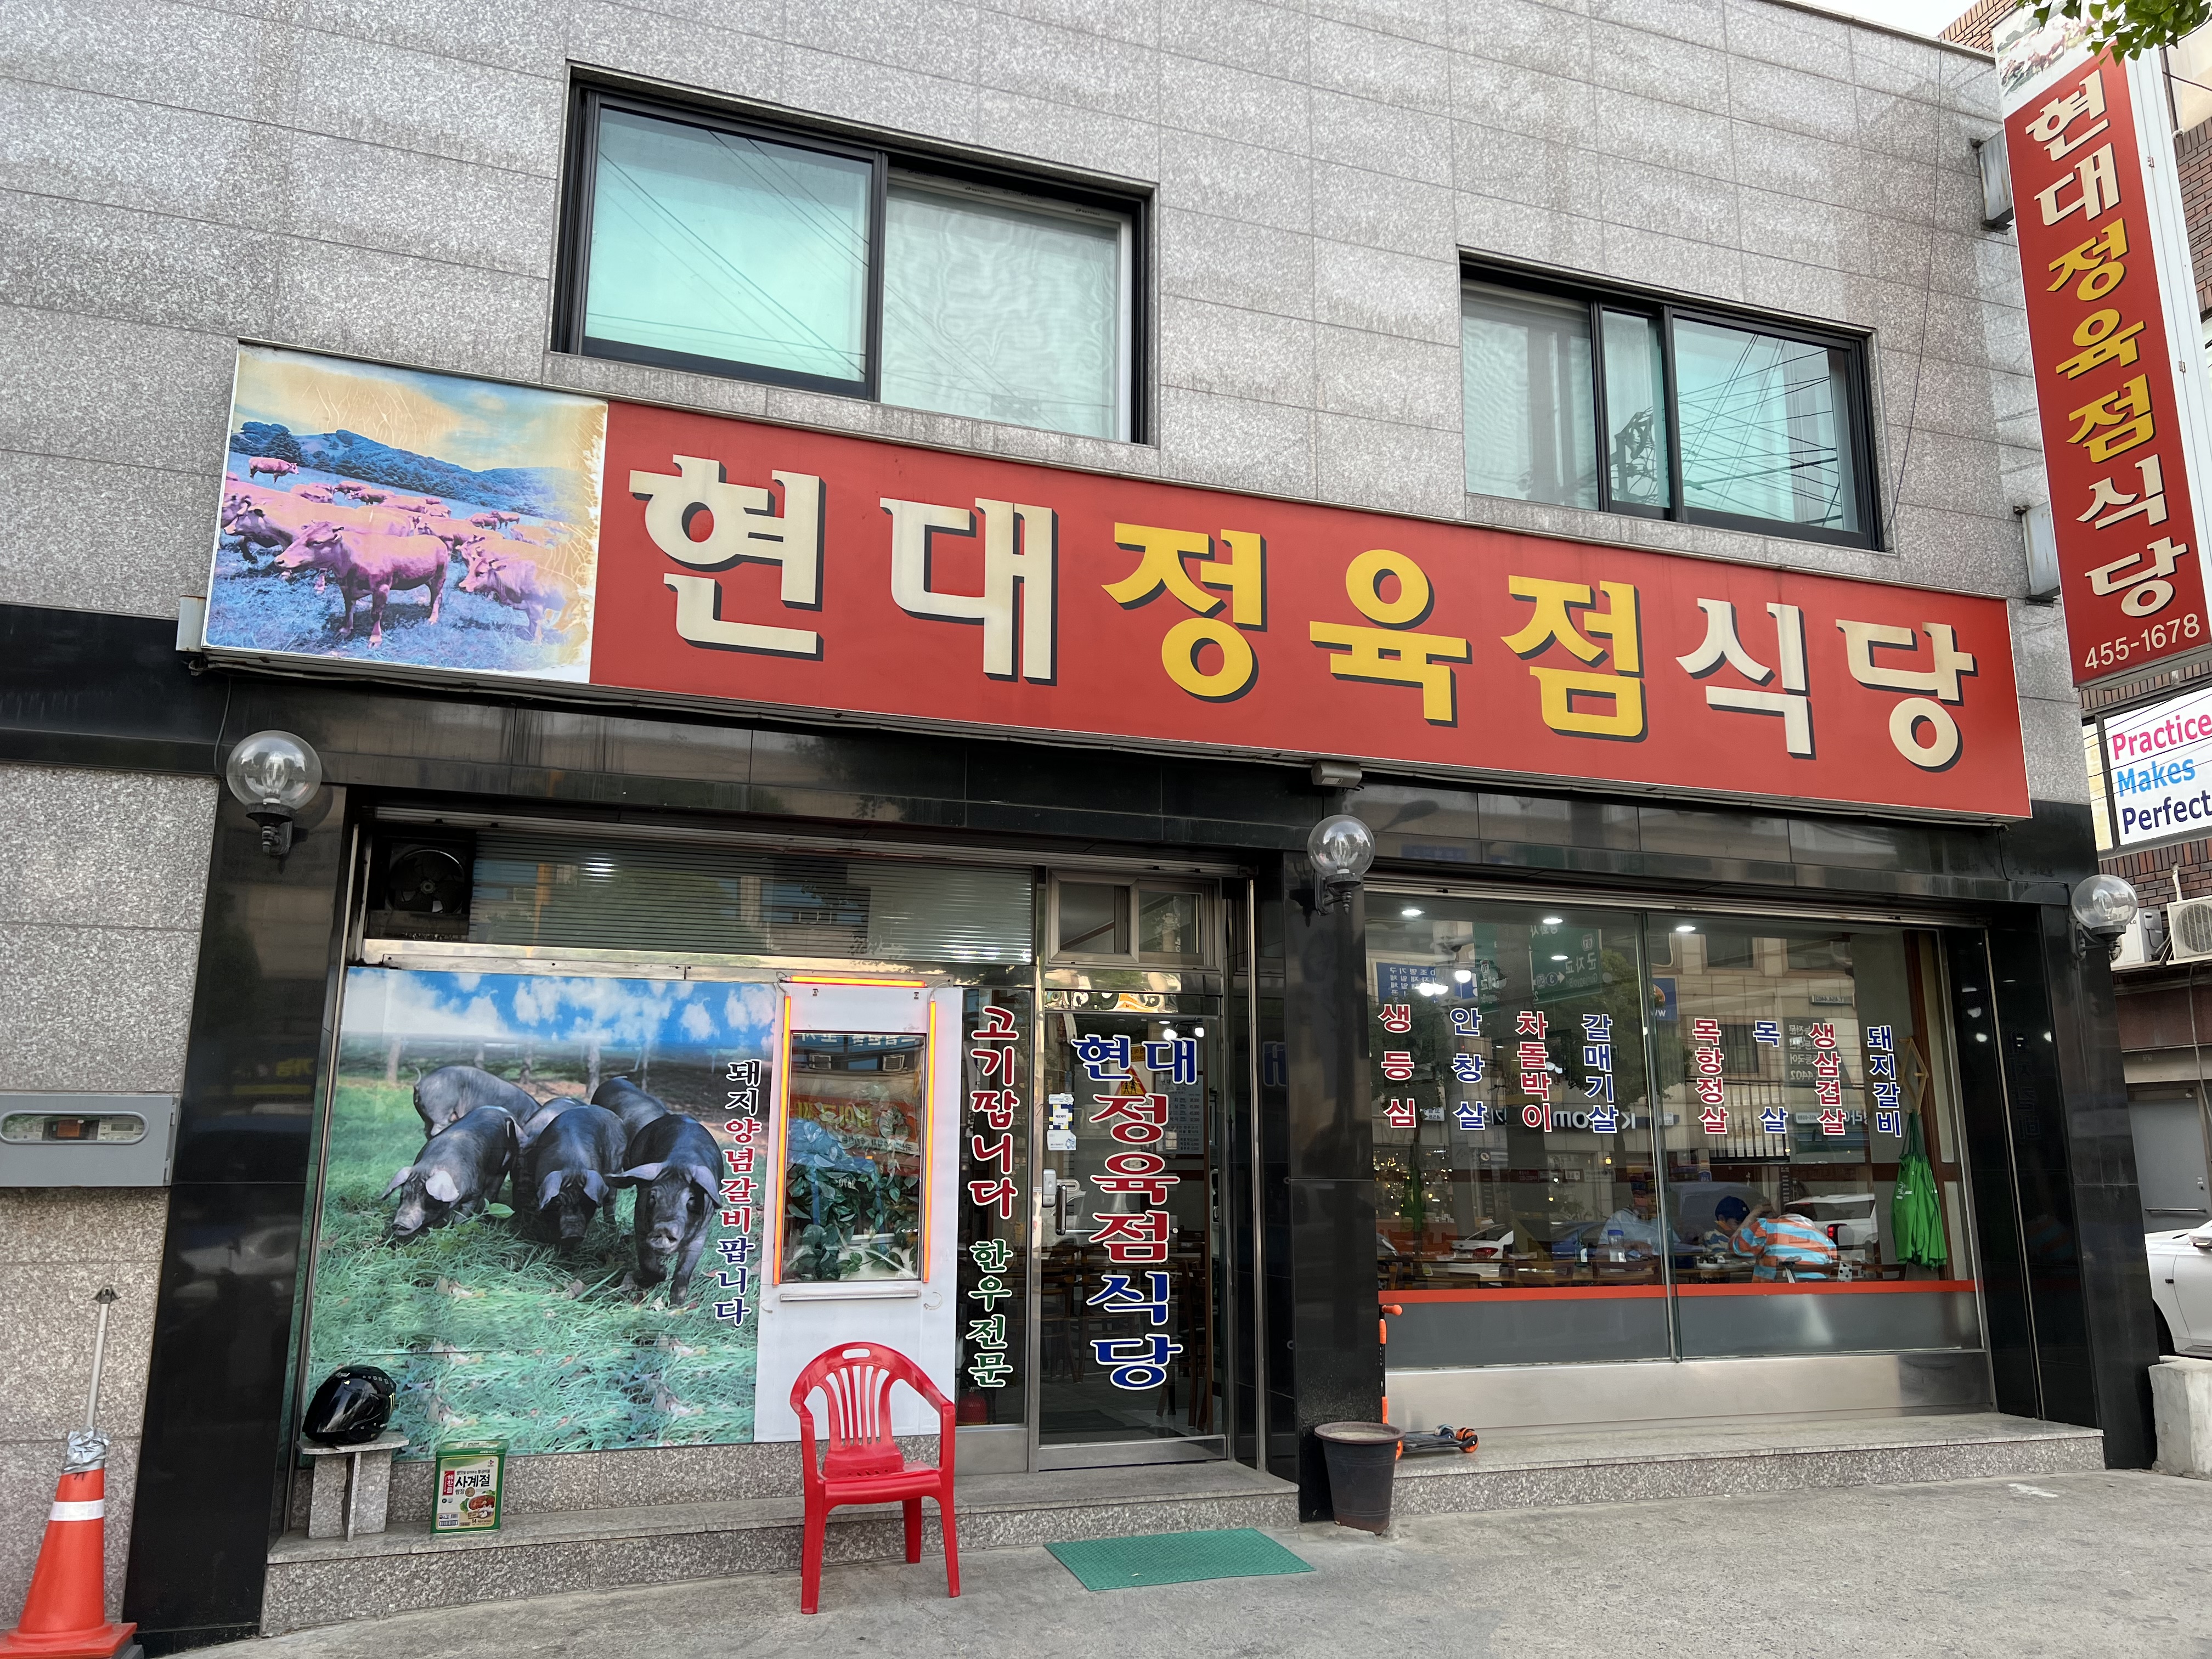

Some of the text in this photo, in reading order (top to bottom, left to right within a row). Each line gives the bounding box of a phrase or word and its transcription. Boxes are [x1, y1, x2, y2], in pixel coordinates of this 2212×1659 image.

[2085, 613, 2200, 669] 455-1678
[2112, 714, 2212, 760] Practice
[2117, 759, 2196, 797] Makes
[2121, 789, 2212, 834] Perfect
[1071, 1034, 1199, 1086] 현대
[1378, 1003, 1417, 1128] 생등심
[1449, 1007, 1486, 1131] 안창살
[1515, 1010, 1553, 1133] 차돌박이
[1581, 1013, 1620, 1134] 갈매기살
[1692, 1018, 1729, 1135] 목항정살
[1752, 1020, 1788, 1135] 목살
[1808, 1022, 1847, 1136] 생삼겹살
[1866, 1025, 1903, 1138] 돼지갈비
[713, 1059, 763, 1327] 돼지양념갈비팝니다
[965, 1005, 1020, 1389] 고기팝니다 한우전문
[455, 1474, 490, 1488] 사계절
